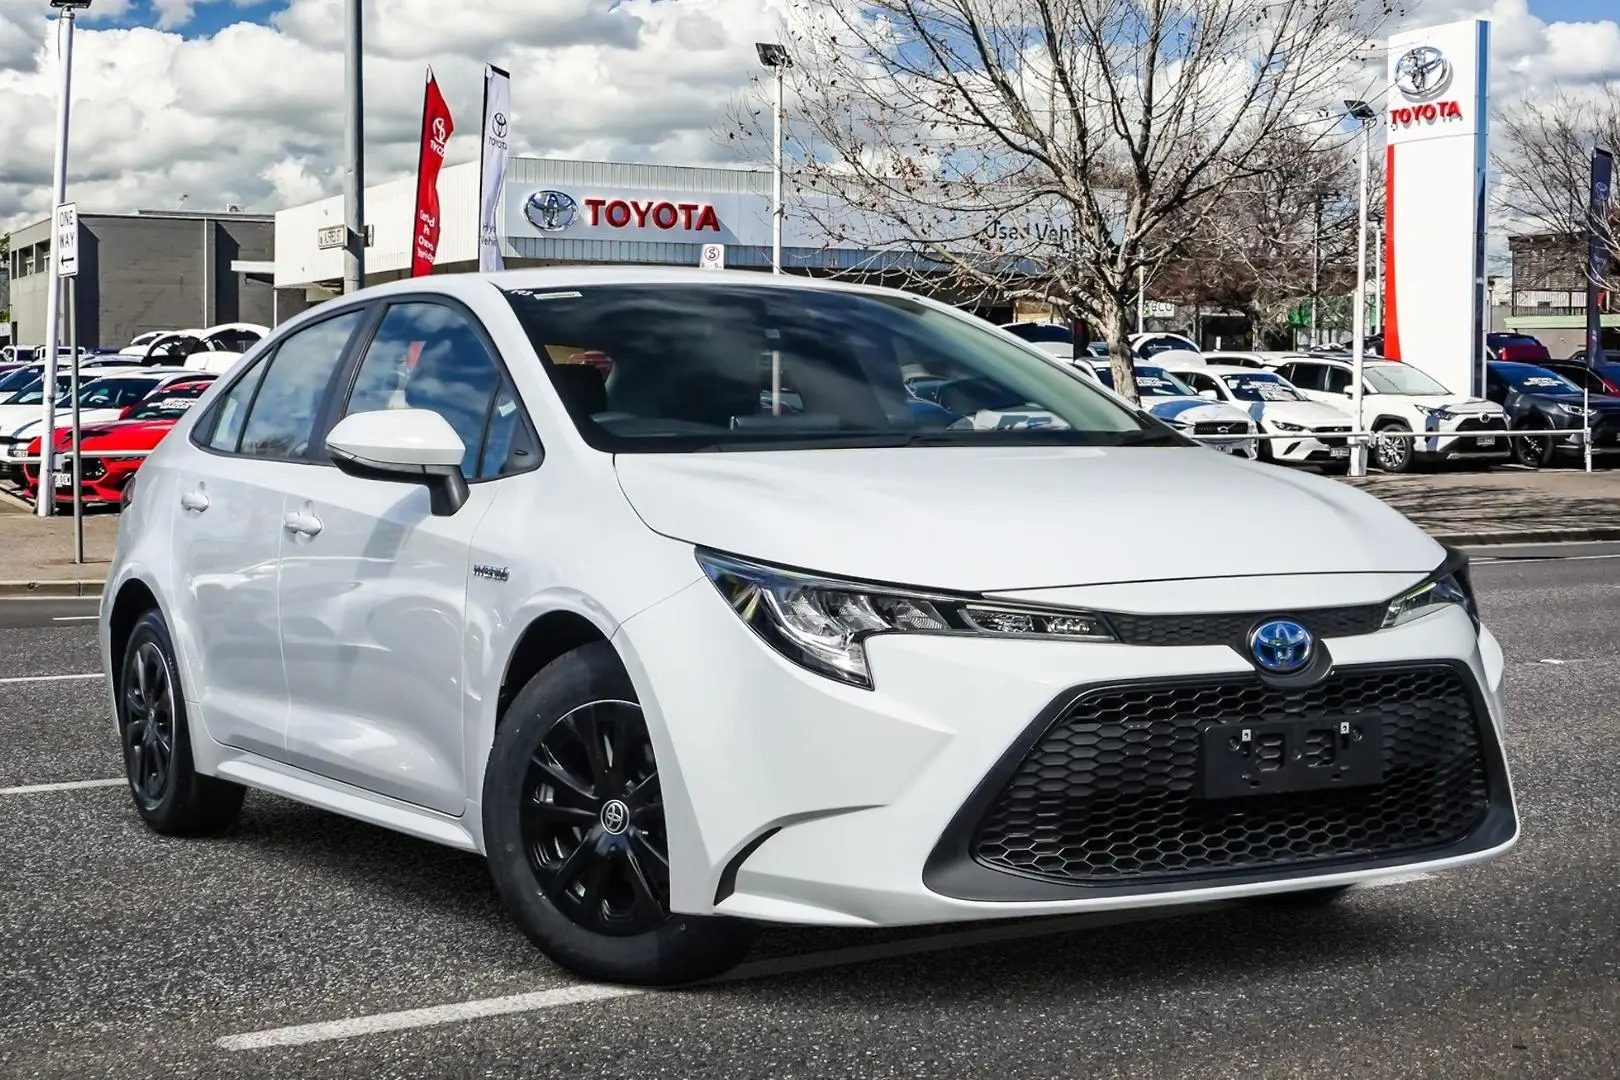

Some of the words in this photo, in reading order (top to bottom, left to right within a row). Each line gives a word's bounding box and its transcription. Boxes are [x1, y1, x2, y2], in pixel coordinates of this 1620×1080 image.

[1390, 101, 1462, 125] TOYOTA
[488, 137, 508, 150] TOYOTA
[60, 209, 74, 227] ONE
[584, 198, 720, 231] TOYOTA
[60, 231, 75, 248] WAY
